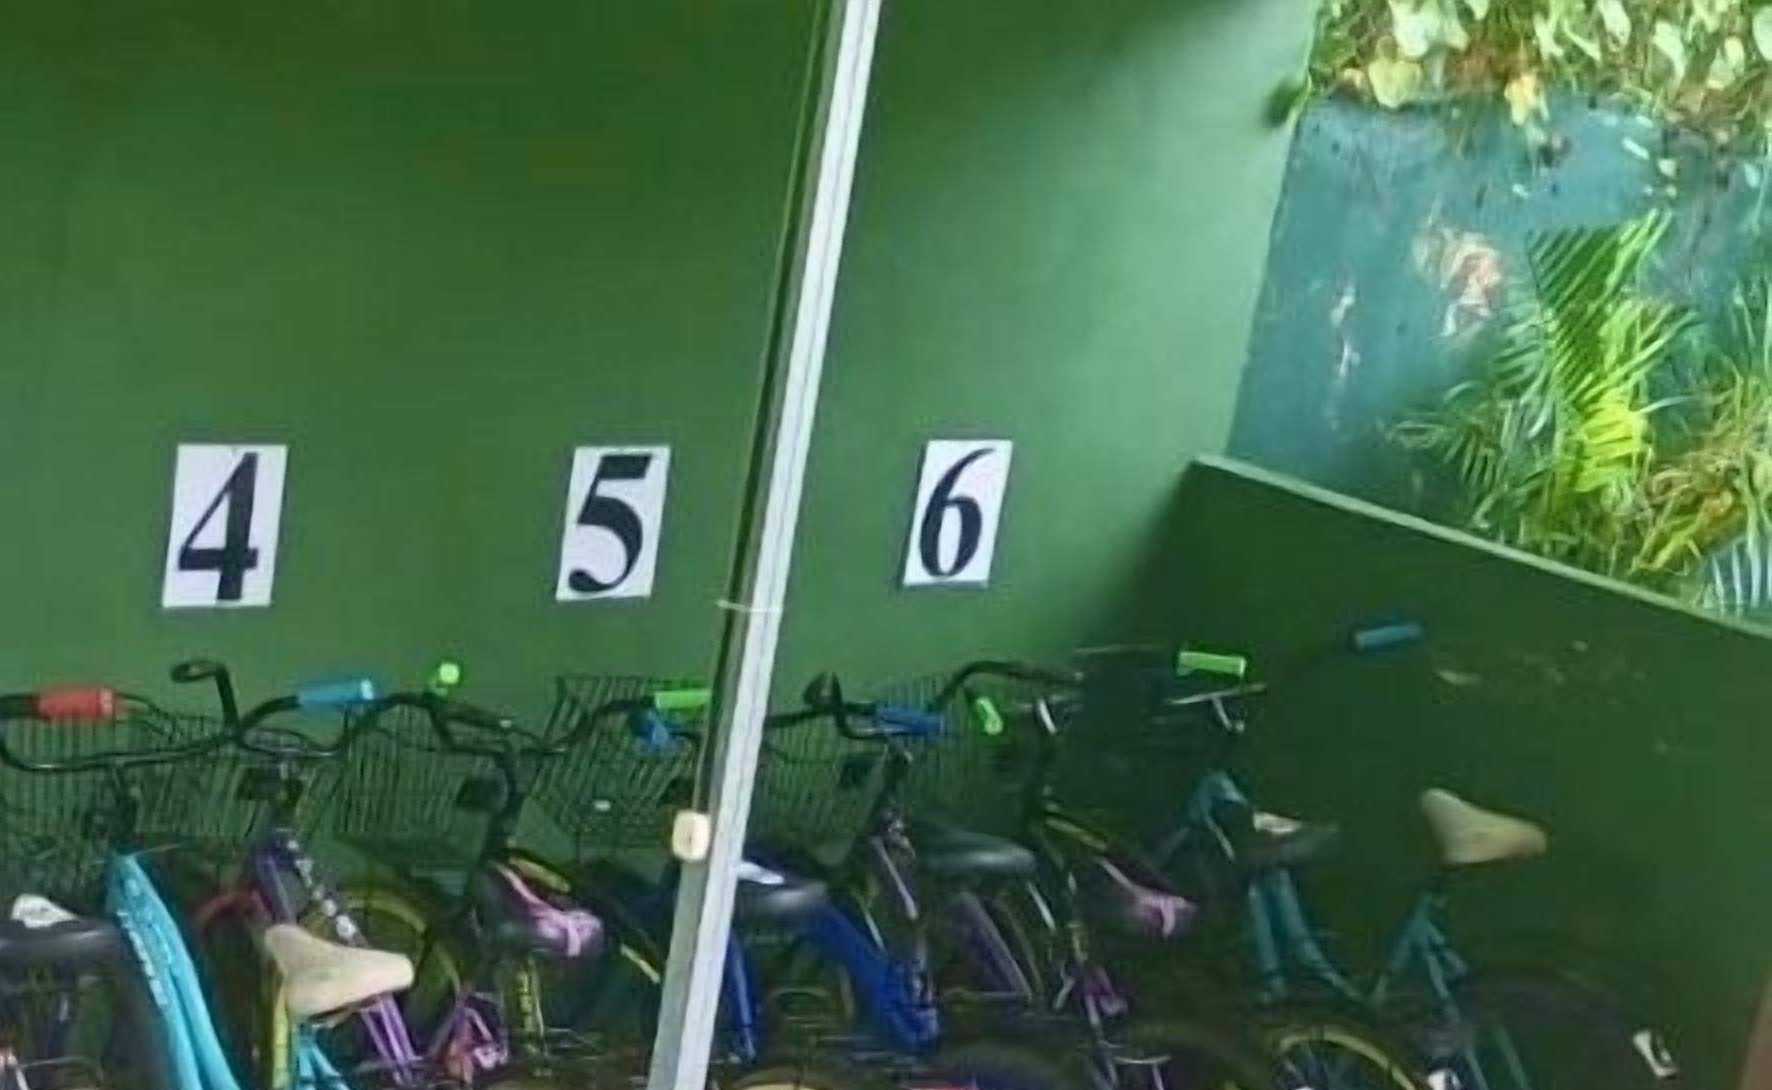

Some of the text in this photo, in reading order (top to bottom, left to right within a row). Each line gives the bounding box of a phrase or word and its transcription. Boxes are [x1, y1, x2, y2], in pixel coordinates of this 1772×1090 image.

[177, 452, 259, 602] 4
[568, 453, 653, 595] 5
[918, 446, 992, 578] 6
